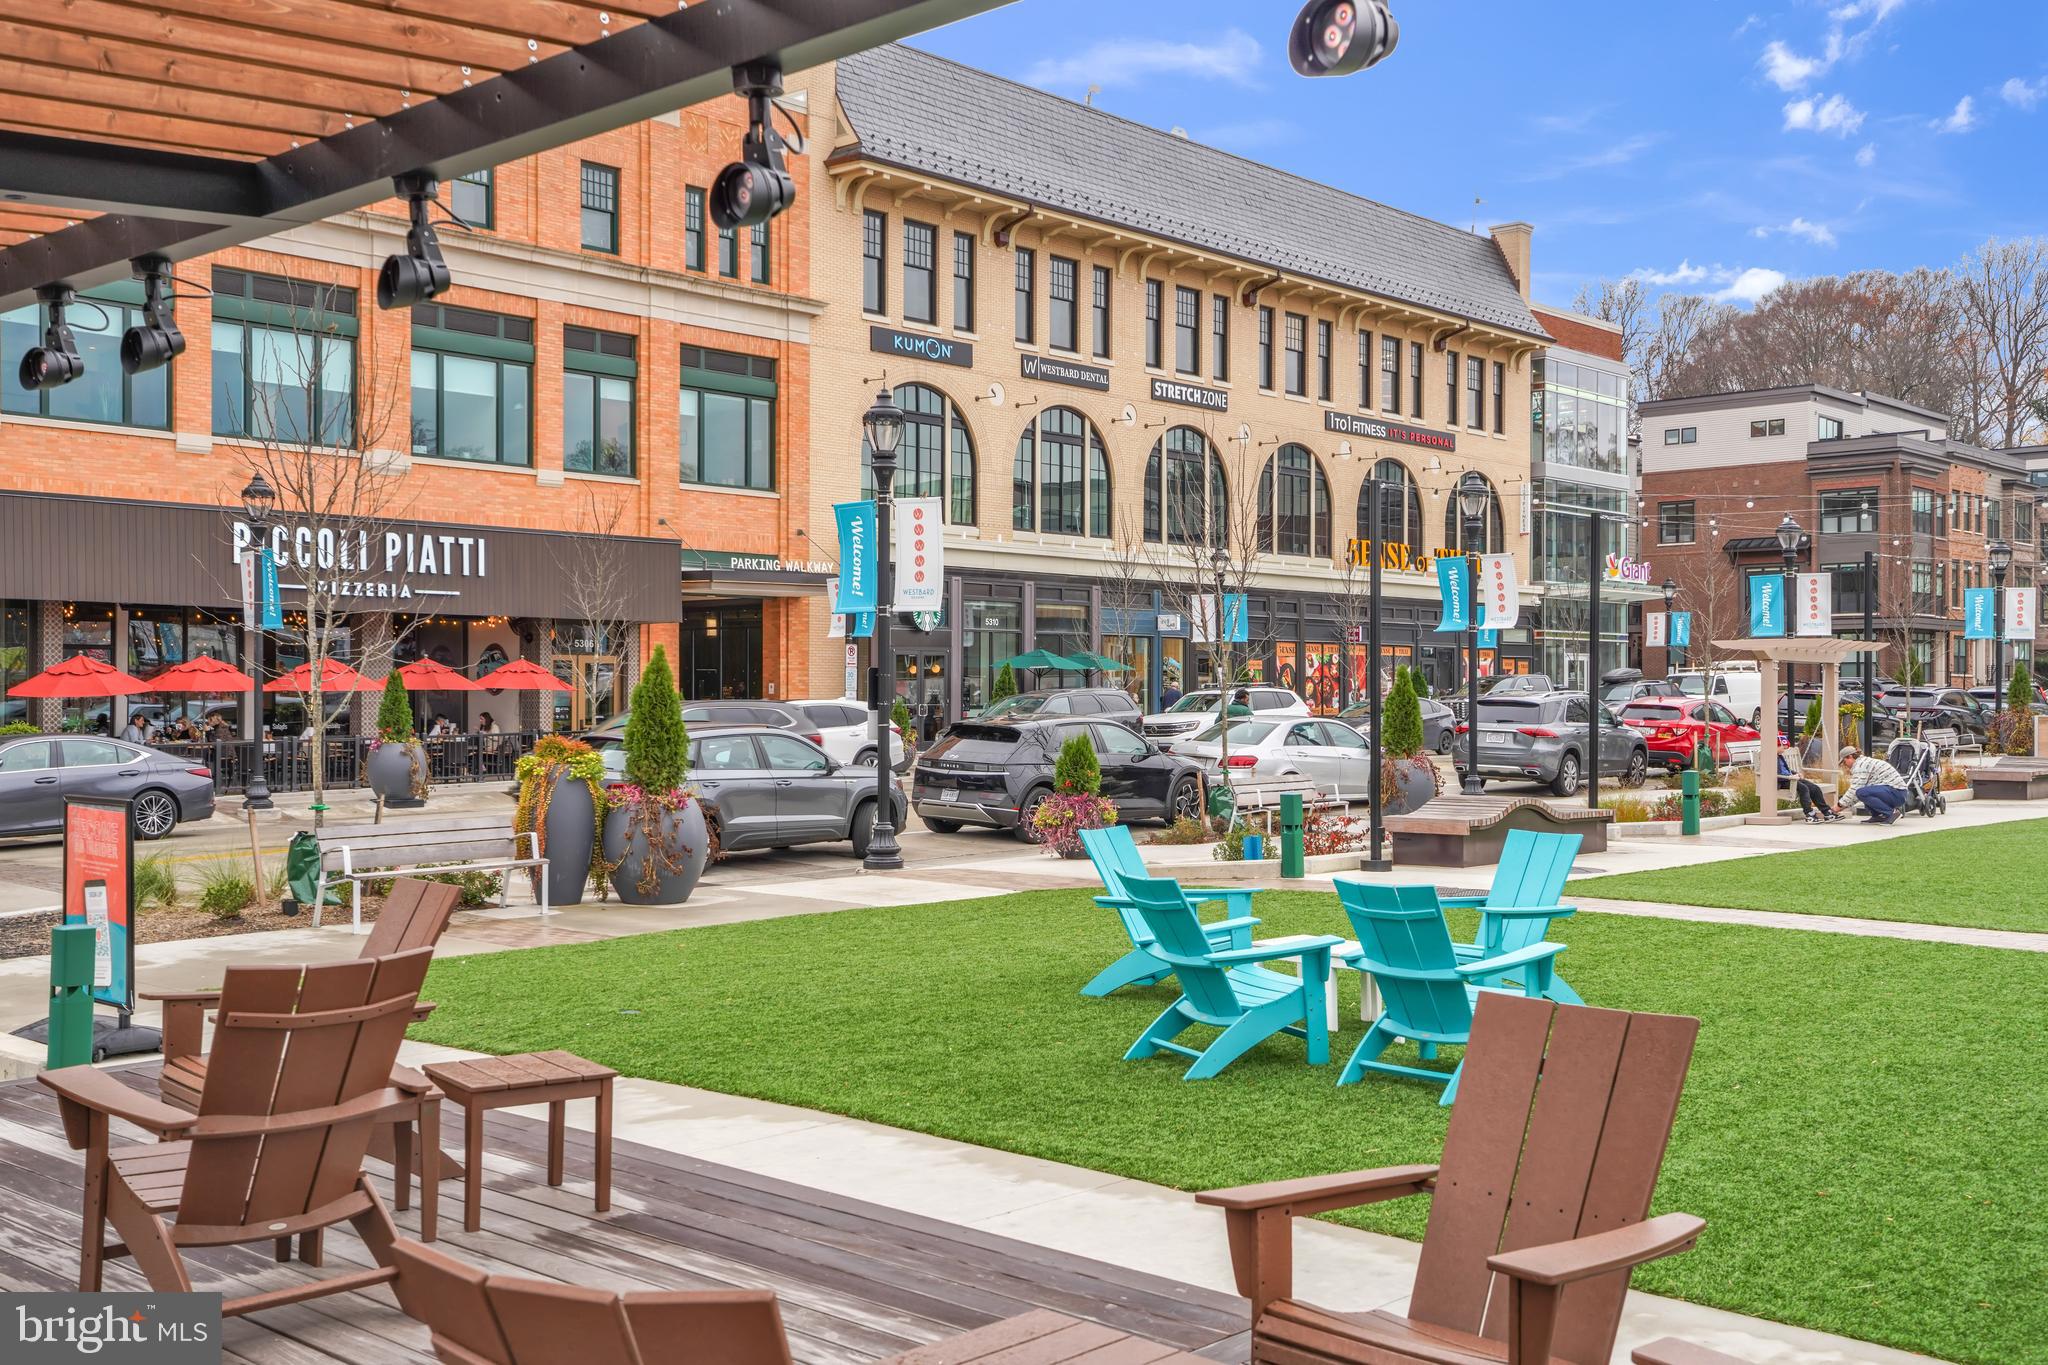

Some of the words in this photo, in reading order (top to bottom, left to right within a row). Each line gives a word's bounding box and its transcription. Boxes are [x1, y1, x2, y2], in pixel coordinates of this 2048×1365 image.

[894, 335, 951, 359] KUMON
[1040, 363, 1080, 379] WESTBARD
[1080, 371, 1109, 385] DENTAL
[1154, 381, 1201, 403] STRETCH
[1202, 391, 1227, 408] ZONE
[1388, 428, 1406, 440] IT'S
[1410, 432, 1455, 448] PERSONAL
[232, 521, 367, 572] PCCOLI
[385, 532, 485, 577] PIATTI
[850, 515, 865, 597] Welcome!
[731, 557, 781, 571] PARKING
[785, 560, 834, 574] WALKWAY
[1621, 557, 1652, 581] Giant
[317, 580, 412, 598] PIZZERIA
[1448, 566, 1461, 623] Welcome!
[1762, 582, 1773, 628] Welcome!
[1974, 594, 1984, 632] Welcome!
[985, 617, 999, 626] 5310
[574, 639, 595, 648] 5306
